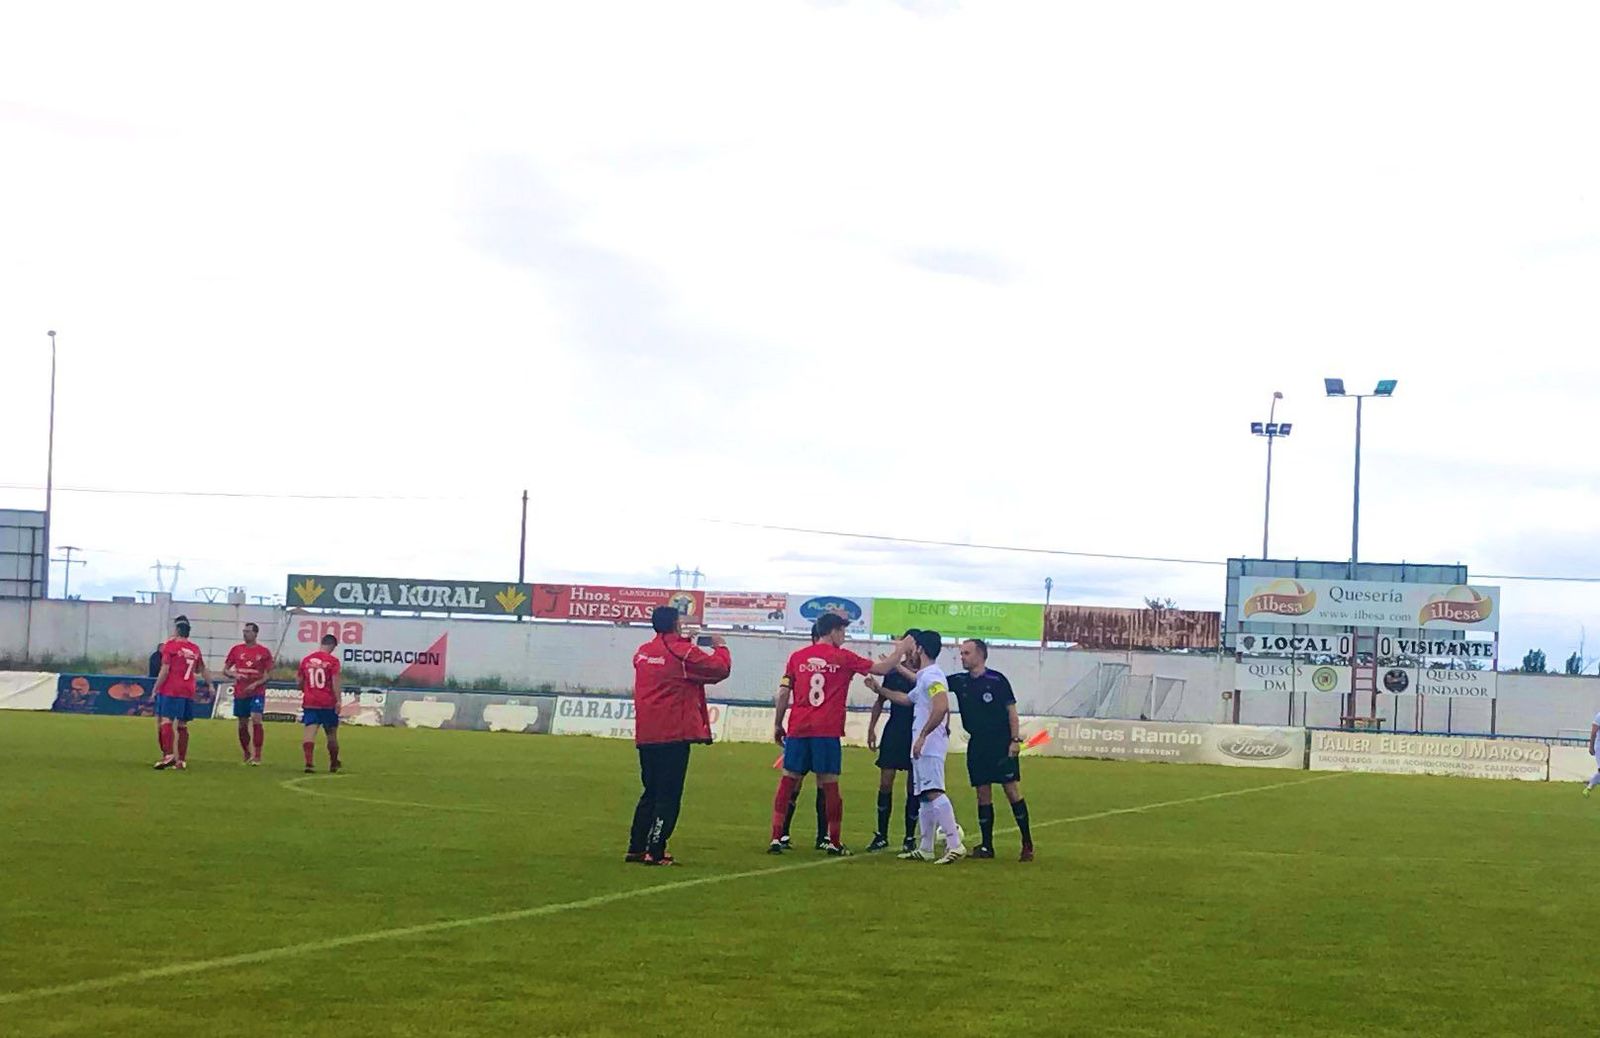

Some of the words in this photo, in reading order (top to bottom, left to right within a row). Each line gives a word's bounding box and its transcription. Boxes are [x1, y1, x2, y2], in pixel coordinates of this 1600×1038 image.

[333, 582, 394, 605] CAJA
[398, 584, 486, 608] RURAL
[570, 587, 616, 601] Hnos.
[1329, 585, 1403, 604] Quesería
[568, 602, 655, 619] INFESTAS
[1255, 595, 1304, 613] ilbesa
[1431, 602, 1481, 620] ilbesa
[297, 619, 364, 645] ana
[1261, 636, 1332, 652] LOCAL
[1397, 640, 1494, 657] VISITANTE
[343, 648, 440, 666] DECORACION
[183, 658, 195, 681] 7
[308, 667, 326, 689] 10
[1248, 664, 1303, 678] QUESOS
[1426, 669, 1478, 682] QUESOS
[808, 673, 826, 707] 8
[1264, 680, 1287, 691] DM
[1416, 684, 1489, 697] FUNDADOR
[1046, 722, 1125, 742] Talleres
[1131, 726, 1202, 745] Ramón
[1231, 736, 1277, 756] Ford
[1318, 734, 1372, 753] TALLER
[1380, 736, 1463, 759] ELÉCTRICO
